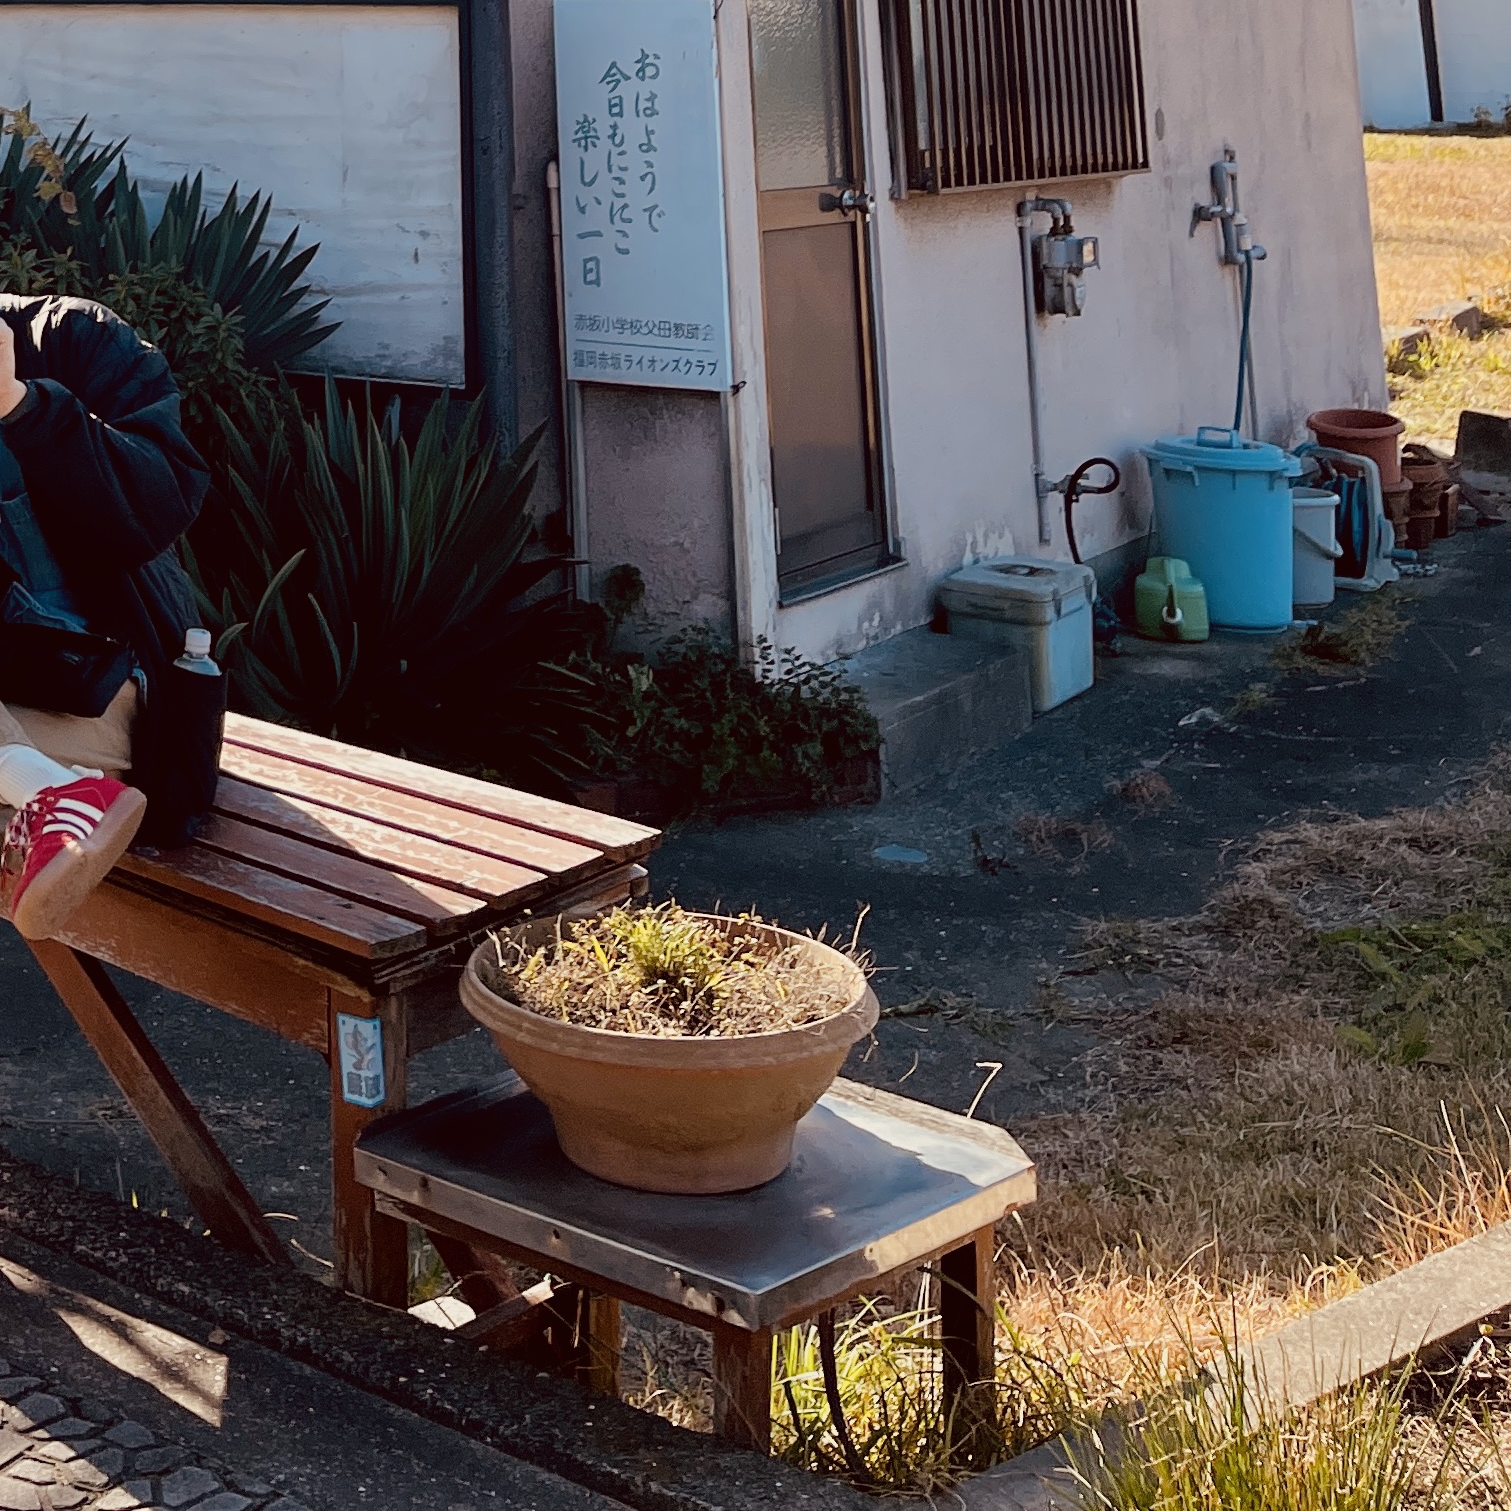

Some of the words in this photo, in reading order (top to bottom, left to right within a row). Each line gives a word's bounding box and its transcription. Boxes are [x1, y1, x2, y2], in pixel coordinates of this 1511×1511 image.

[571, 113, 604, 288] 楽しい一日
[598, 60, 633, 256] 今日もにこにこ
[633, 48, 666, 233] おはようで
